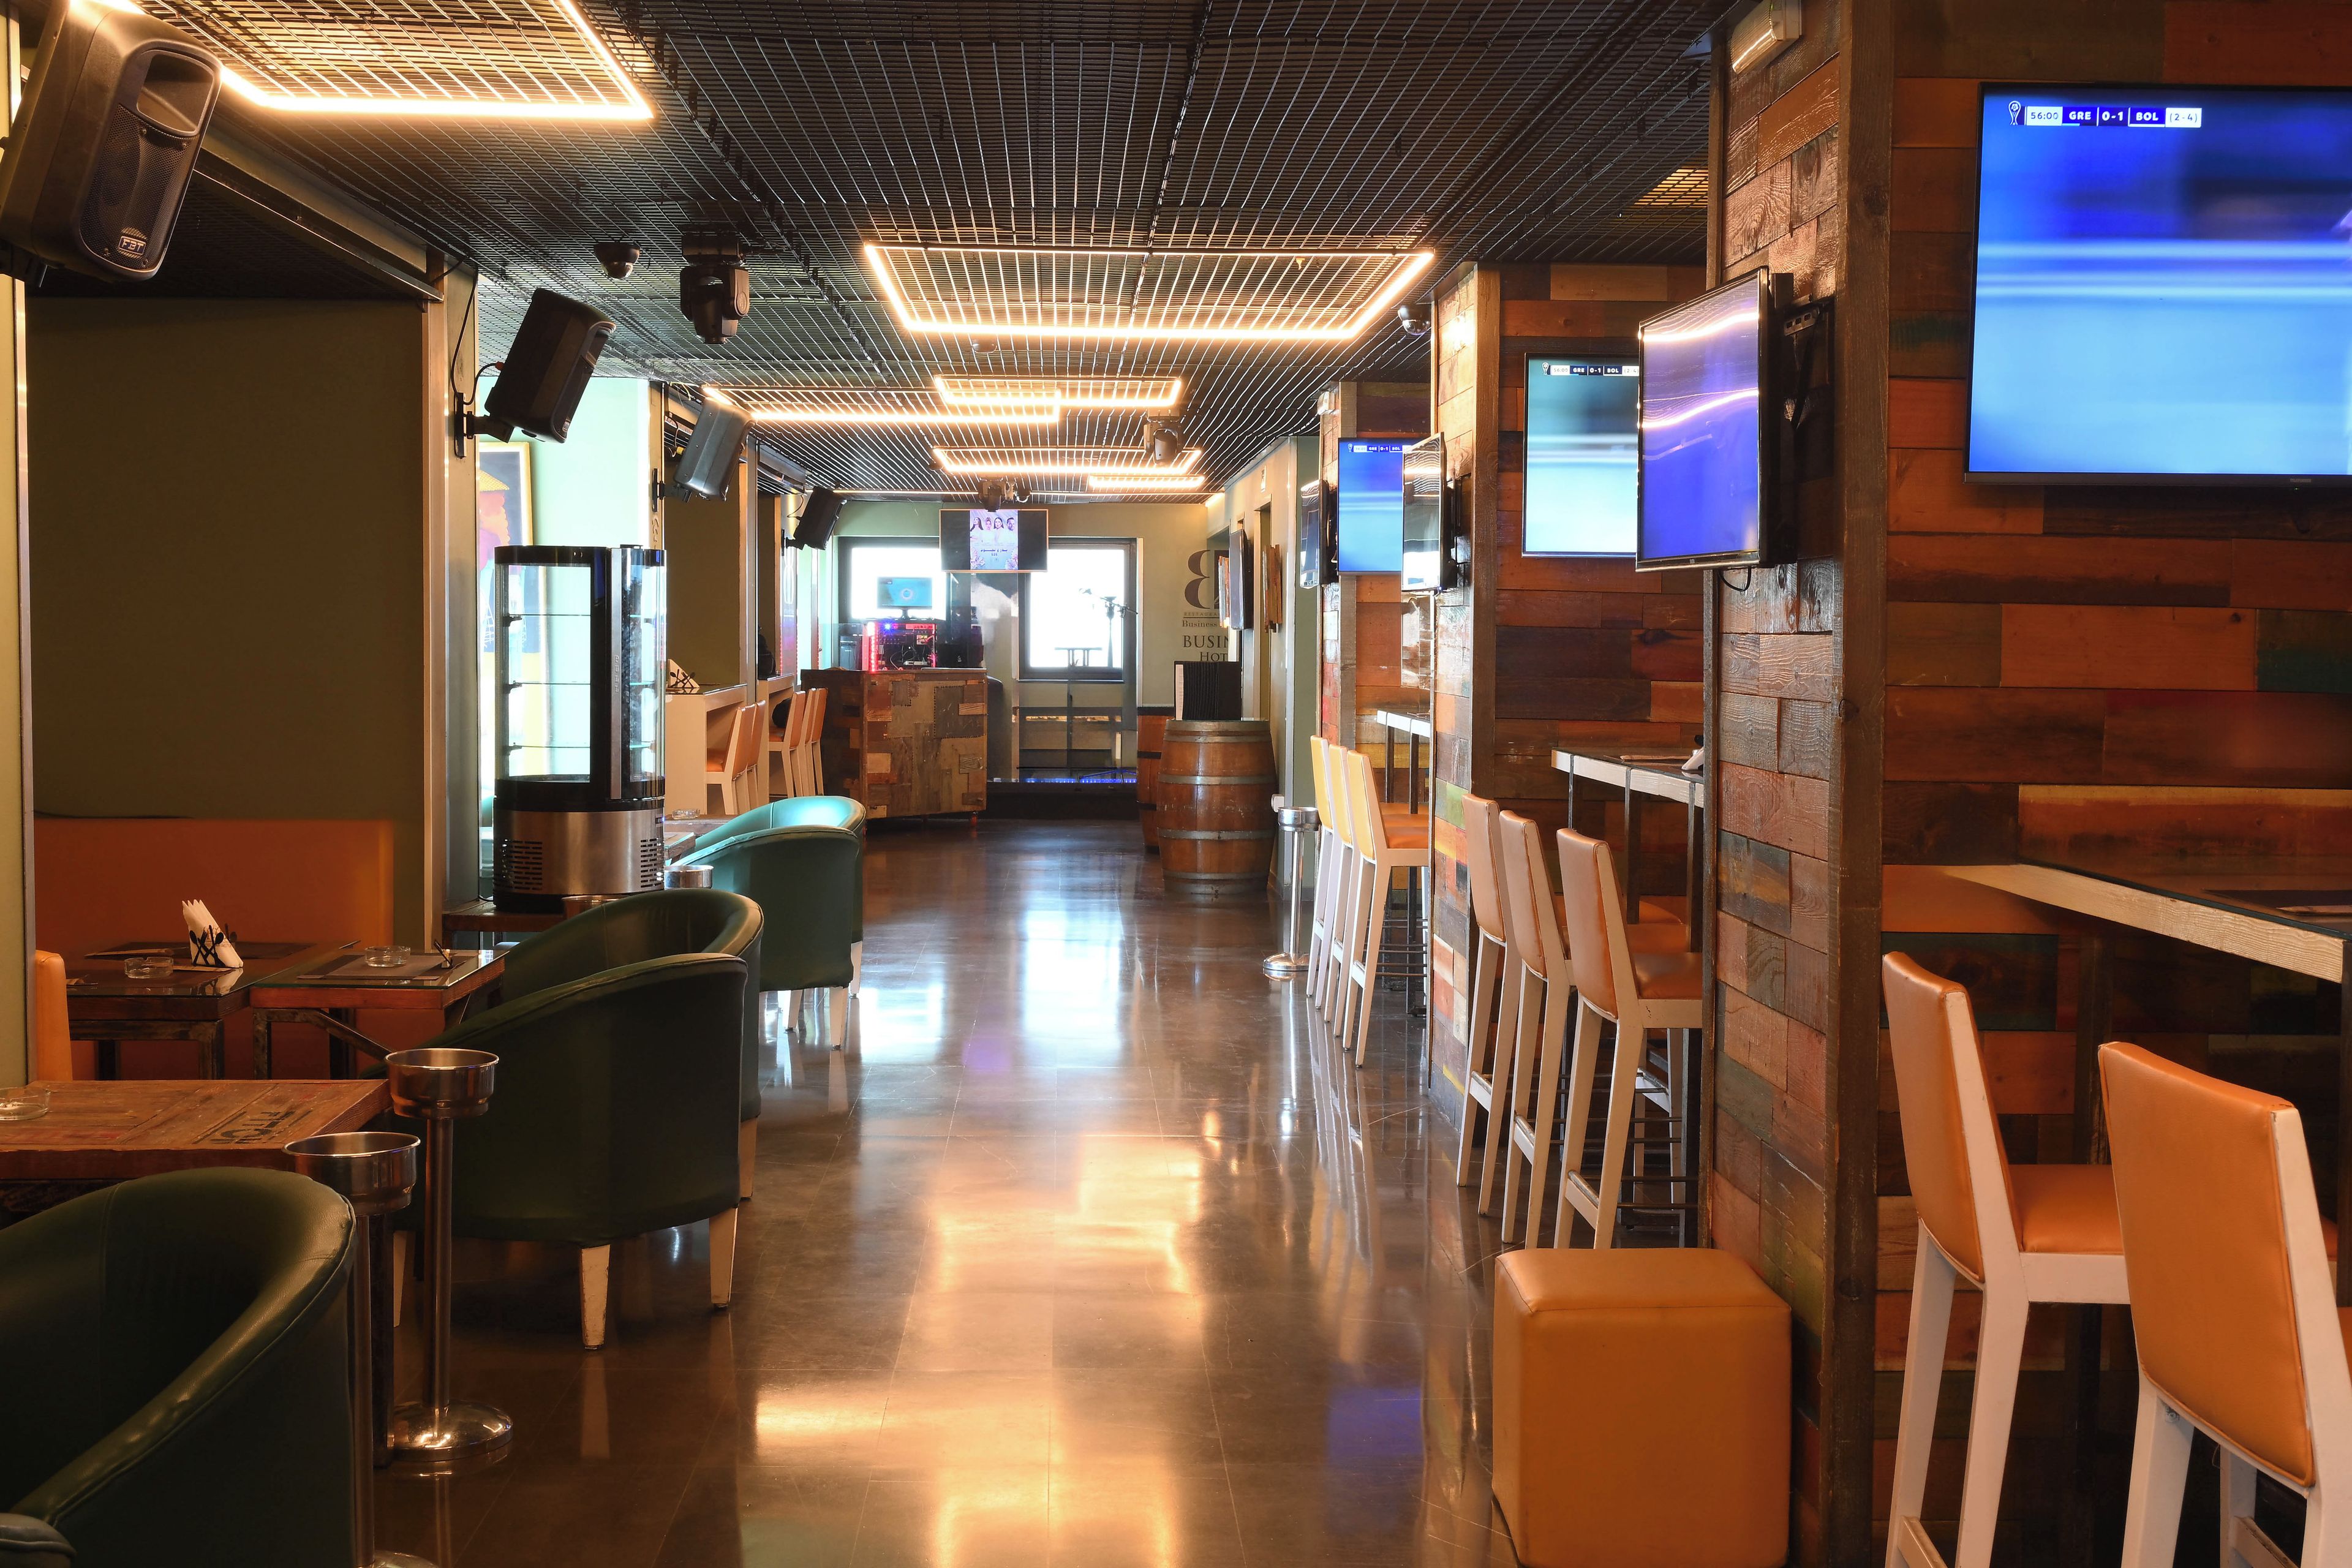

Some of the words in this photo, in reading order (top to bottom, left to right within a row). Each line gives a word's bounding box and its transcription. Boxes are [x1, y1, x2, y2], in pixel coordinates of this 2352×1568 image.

[2030, 111, 2059, 120] 56:00
[2068, 111, 2092, 121] GRE
[2101, 111, 2124, 121] 0-1
[2136, 112, 2158, 122] BOL
[121, 238, 145, 252] FBT
[1200, 652, 1229, 662] HOT
